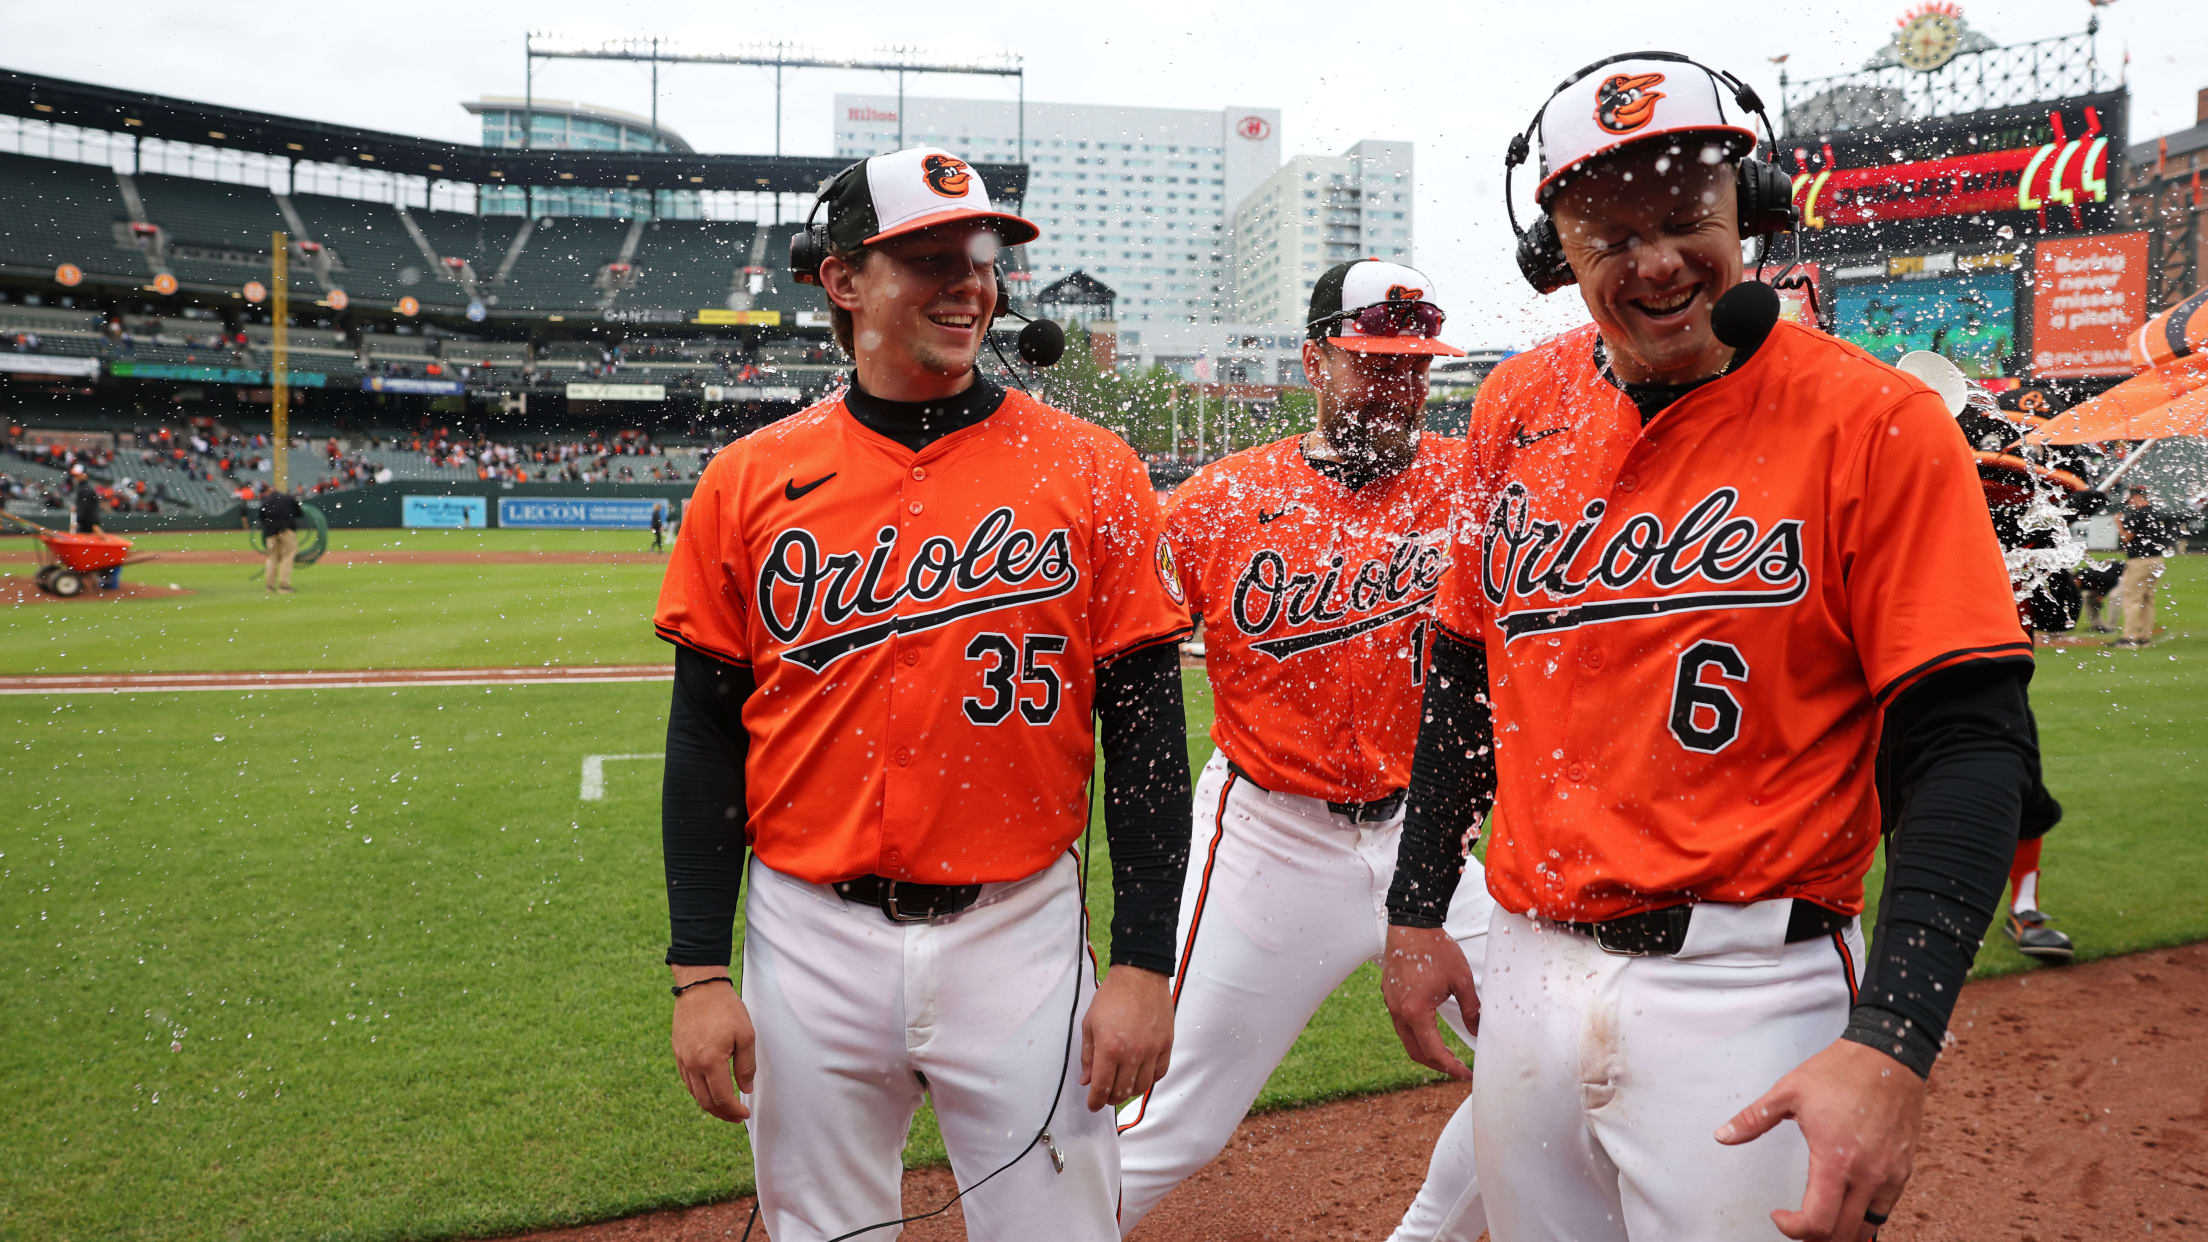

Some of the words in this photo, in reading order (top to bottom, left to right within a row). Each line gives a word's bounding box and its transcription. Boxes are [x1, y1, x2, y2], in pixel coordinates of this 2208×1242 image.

[848, 107, 898, 121] Hilton
[509, 503, 586, 521] LECOM
[1481, 481, 1809, 607] Orioles
[757, 506, 1079, 645] Orioles
[1231, 530, 1440, 637] Oriole
[961, 631, 1069, 727] 35
[1410, 617, 1438, 688] 1
[1667, 638, 1750, 755] 6
